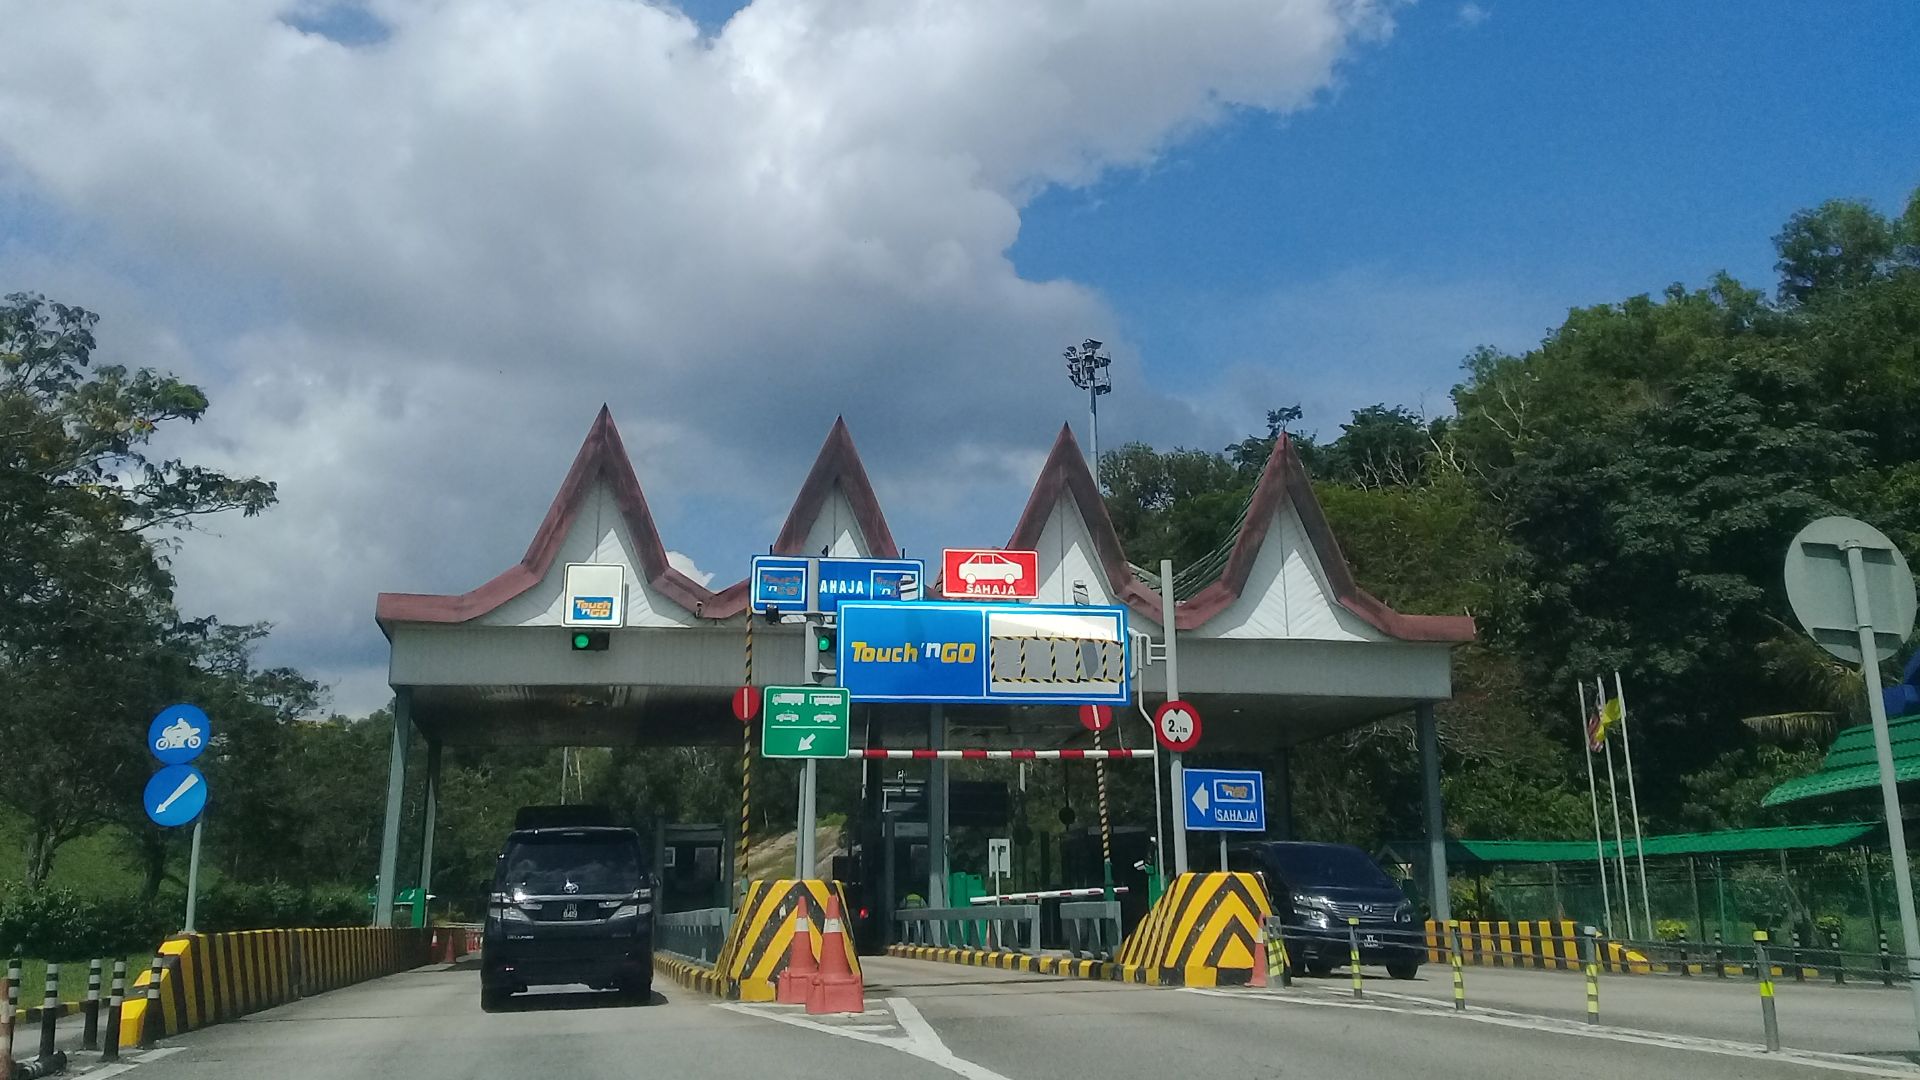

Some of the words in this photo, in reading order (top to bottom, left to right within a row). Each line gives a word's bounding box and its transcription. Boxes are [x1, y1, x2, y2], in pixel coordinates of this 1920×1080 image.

[819, 579, 864, 594] AHAJA
[966, 583, 1016, 595] SAHAJA
[575, 600, 611, 609] Touch
[851, 641, 919, 663] Touch
[1217, 808, 1255, 822] SAHAJA
